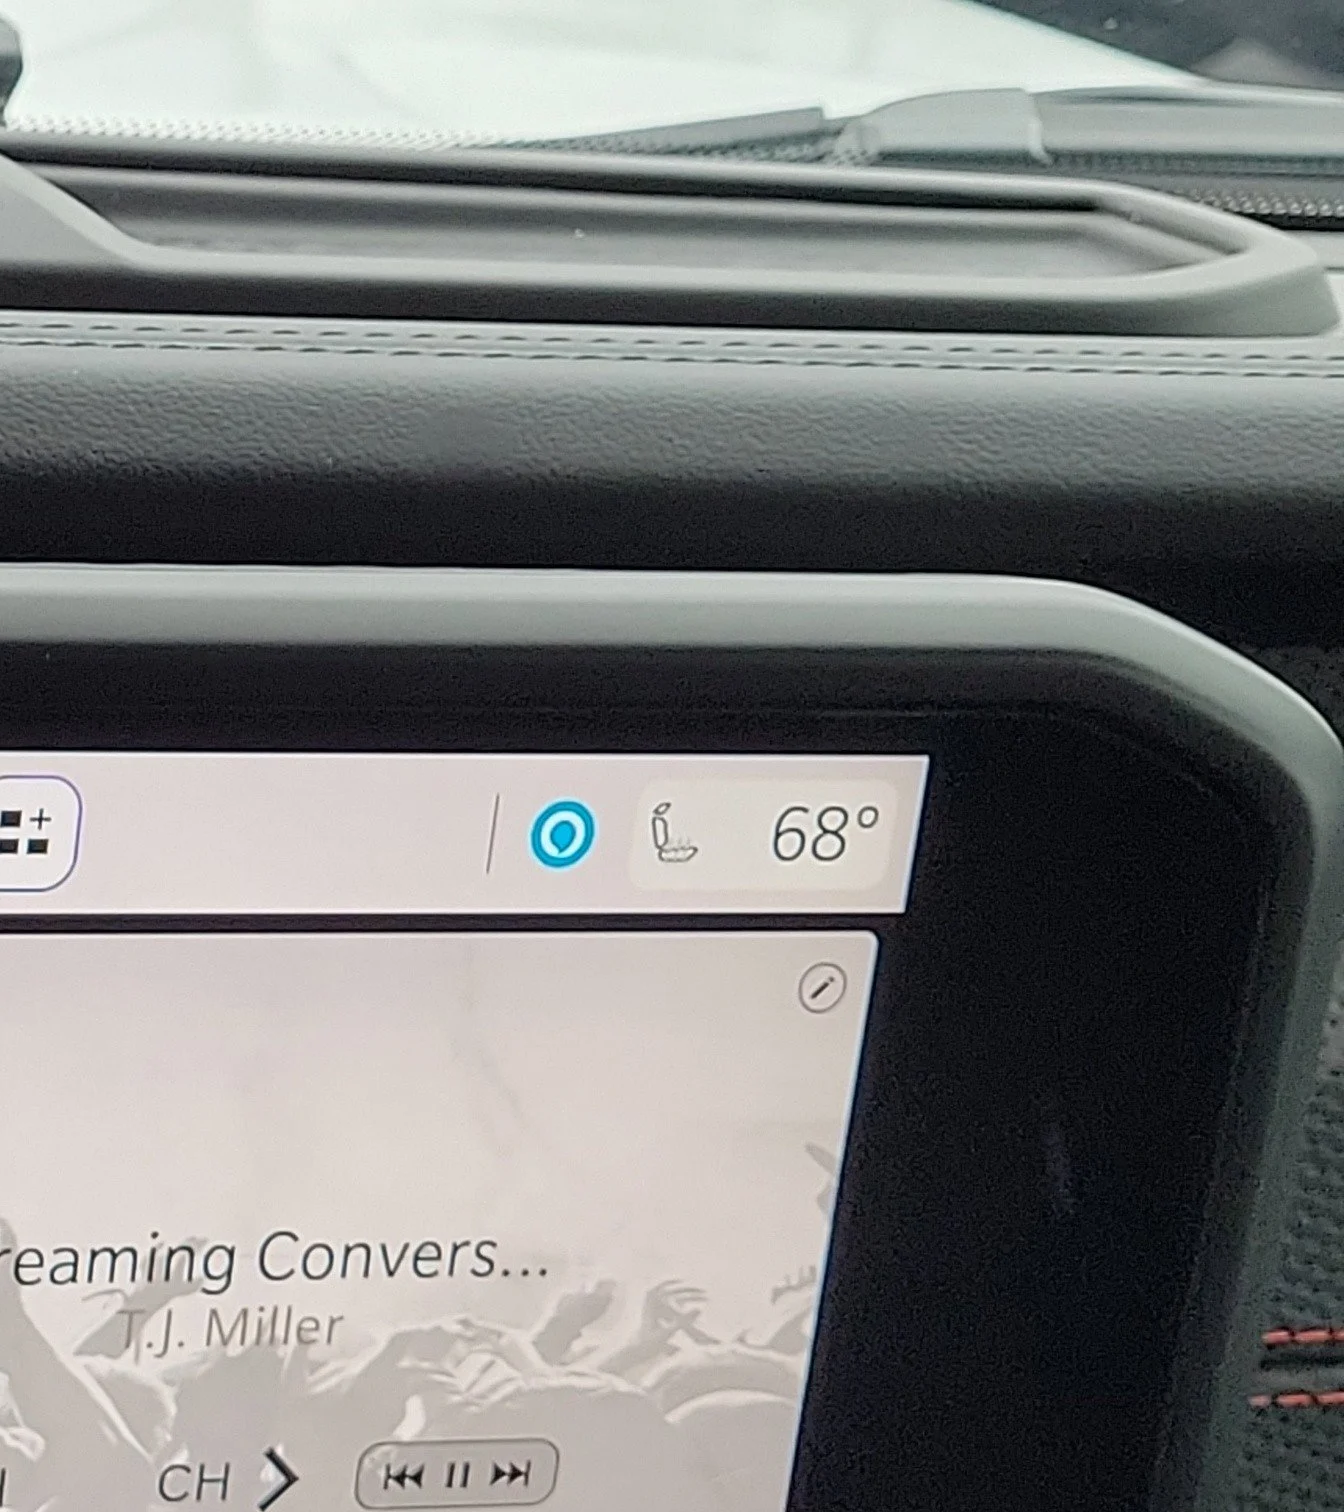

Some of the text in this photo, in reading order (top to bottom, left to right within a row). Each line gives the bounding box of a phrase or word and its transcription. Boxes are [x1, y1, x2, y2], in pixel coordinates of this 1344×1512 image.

[257, 1230, 550, 1282] Convers...
[205, 1304, 344, 1348] Miller
[158, 1463, 231, 1503] CH
